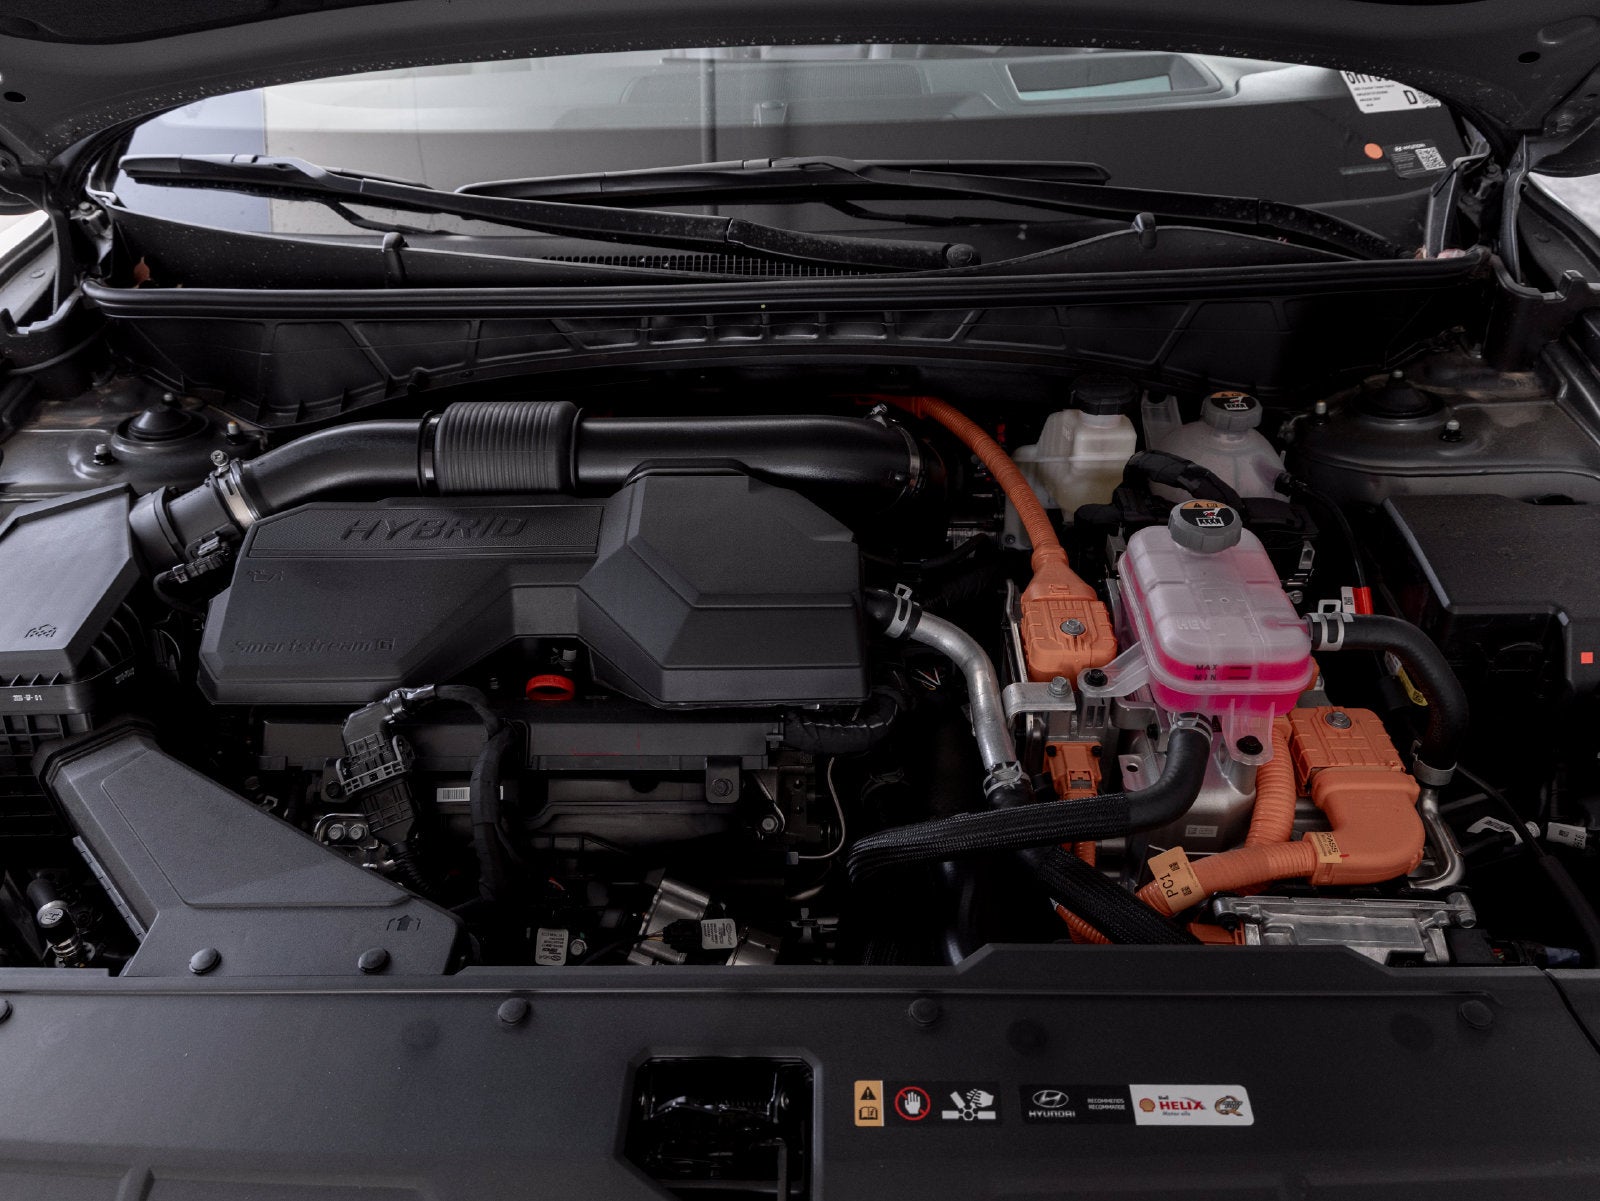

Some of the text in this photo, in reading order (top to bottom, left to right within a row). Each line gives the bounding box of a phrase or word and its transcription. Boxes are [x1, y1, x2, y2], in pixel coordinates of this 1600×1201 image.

[1403, 90, 1418, 104] D
[340, 517, 528, 541] HYBRID
[1195, 663, 1218, 671] MAX
[1194, 673, 1217, 681] MIN
[1159, 872, 1179, 899] PC1
[1159, 1101, 1206, 1111] HELIX
[1028, 1109, 1076, 1118] HYUNDAI
